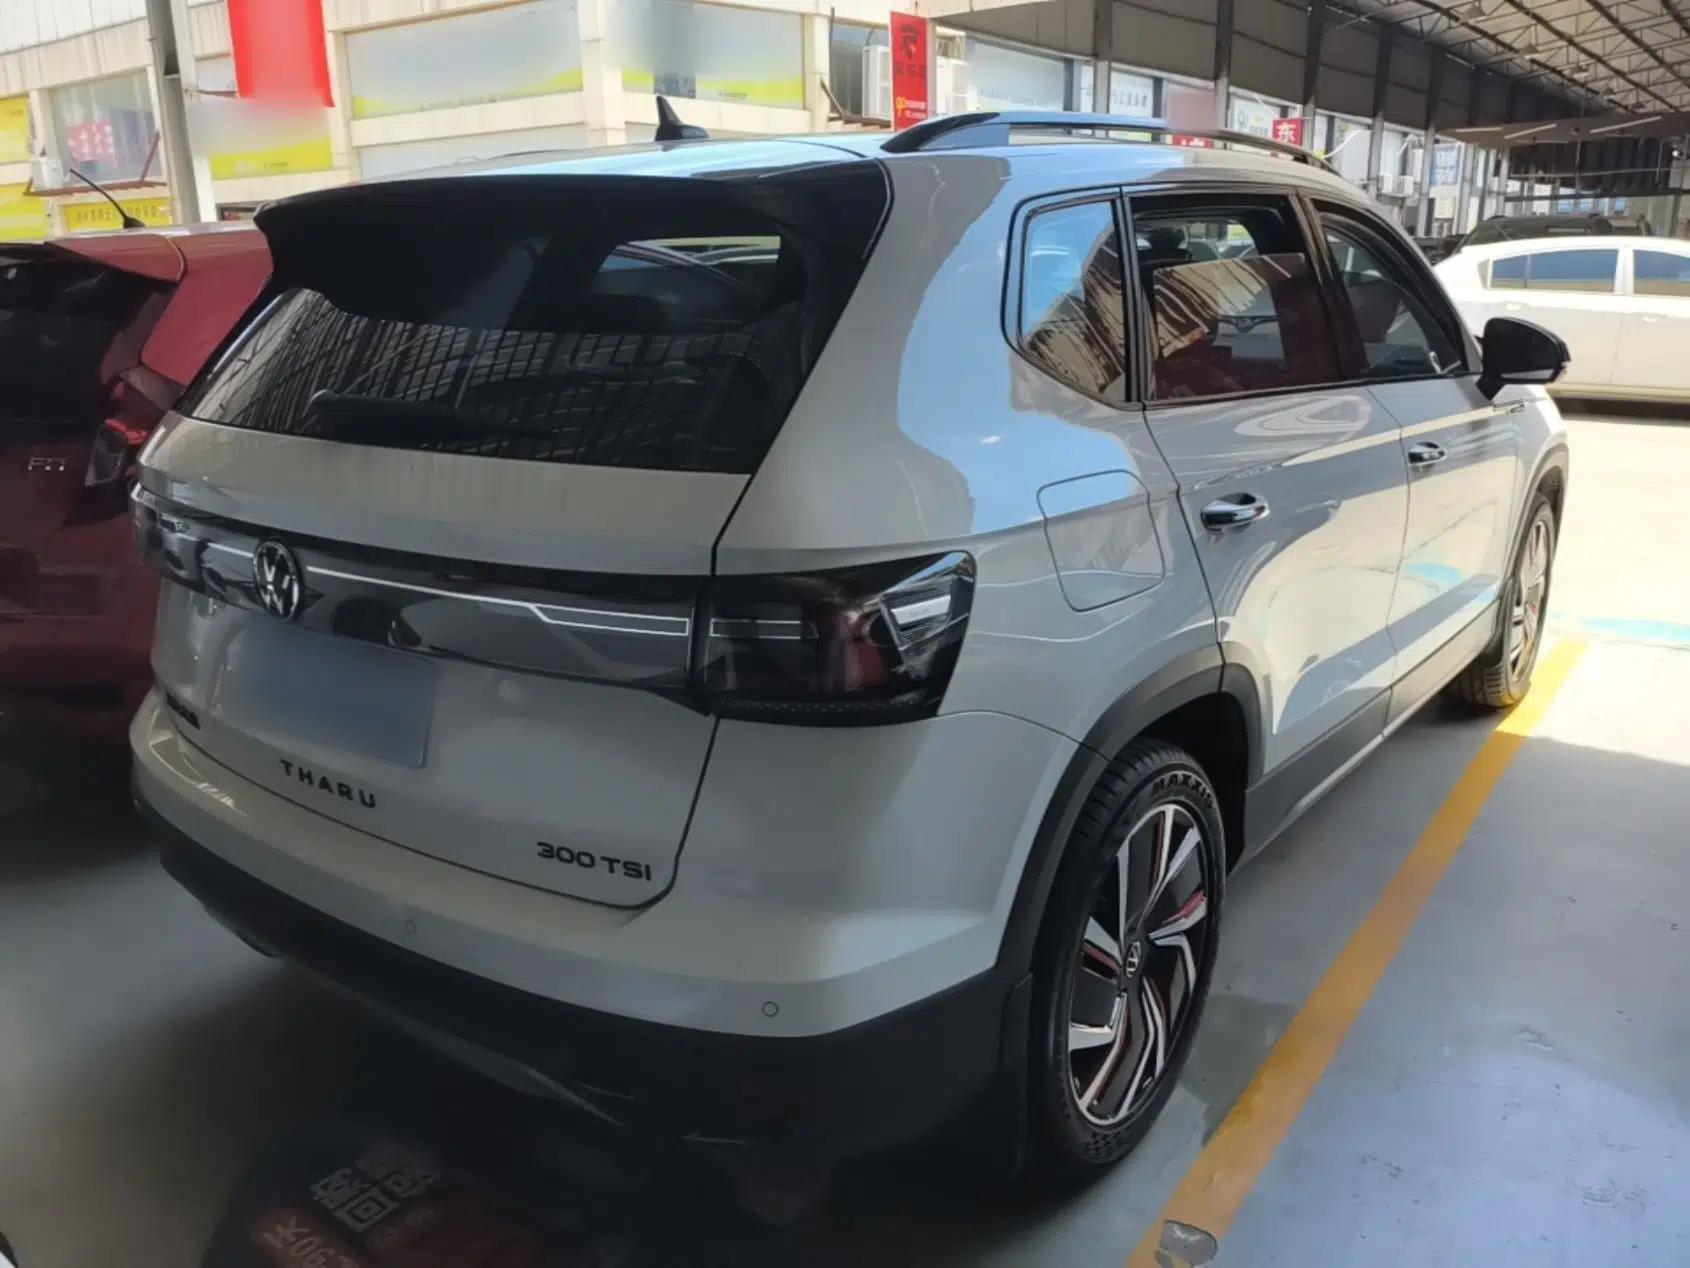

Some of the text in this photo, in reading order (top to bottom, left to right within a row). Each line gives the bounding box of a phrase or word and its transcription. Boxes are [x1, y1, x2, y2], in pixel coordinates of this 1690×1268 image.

[279, 758, 376, 809] THARU
[536, 840, 652, 881] 300 TSI
